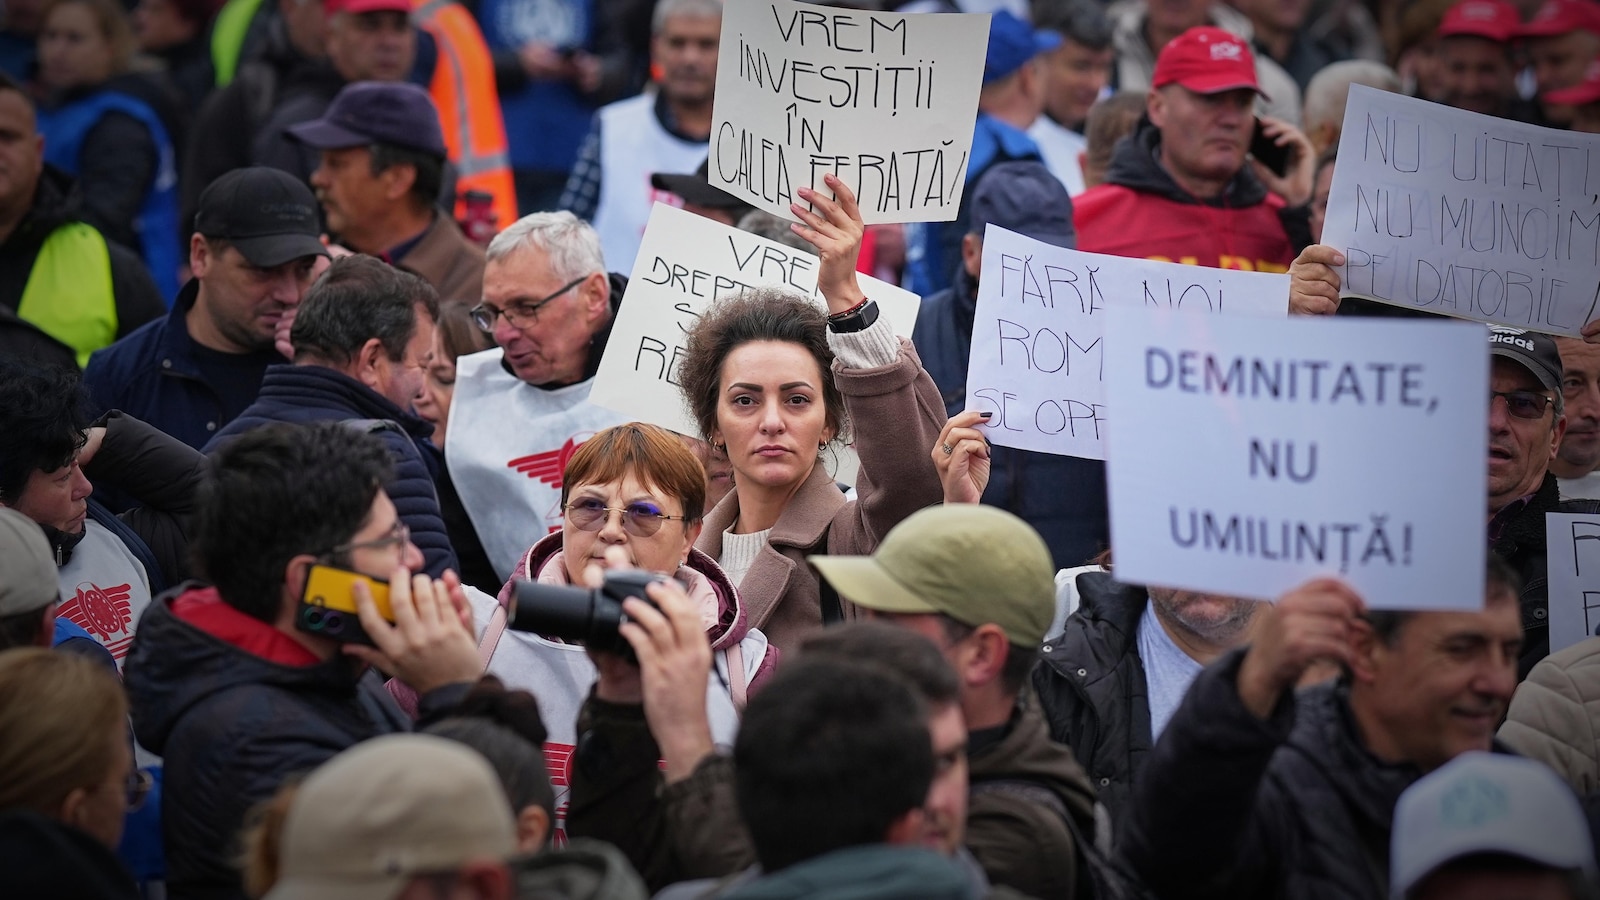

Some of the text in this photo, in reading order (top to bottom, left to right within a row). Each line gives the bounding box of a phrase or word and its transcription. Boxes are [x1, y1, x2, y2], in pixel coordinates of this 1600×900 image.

[771, 4, 906, 56] VREM
[785, 102, 824, 153] ÎN
[1364, 112, 1420, 173] NU
[716, 121, 792, 206] CALEA
[1355, 183, 1600, 266] NU MUNCIM
[642, 256, 757, 301] DREPT
[728, 235, 819, 297] VRE
[1001, 253, 1105, 315] FĂRĂ
[1346, 247, 1392, 300] PE
[997, 318, 1104, 382] ROM
[1487, 333, 1536, 352] didas
[974, 388, 1024, 432] SE
[1143, 346, 1440, 415] DEMNITATE,
[1249, 438, 1319, 485] NU
[1168, 505, 1414, 576] UMILINȚĂ!
